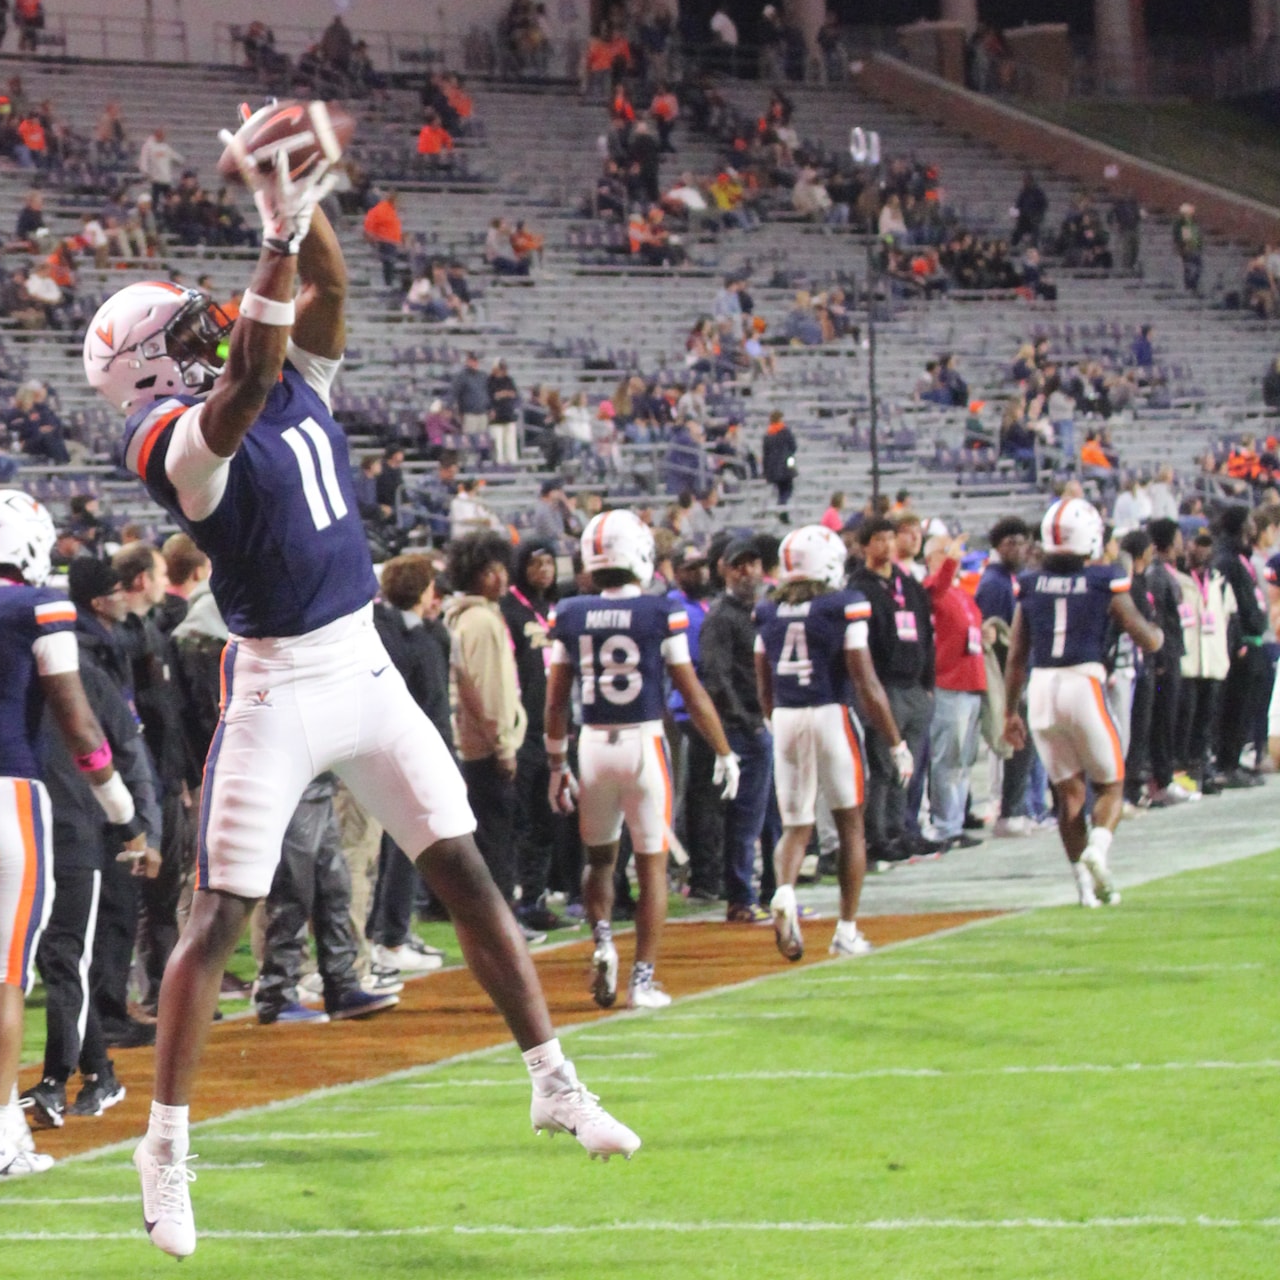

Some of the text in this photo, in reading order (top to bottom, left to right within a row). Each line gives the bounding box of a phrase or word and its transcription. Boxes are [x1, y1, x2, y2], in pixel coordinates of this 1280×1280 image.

[281, 416, 348, 531] 11
[585, 609, 632, 629] MARTIN
[1051, 597, 1067, 658] 1
[579, 634, 643, 705] 18
[776, 621, 813, 686] 4
